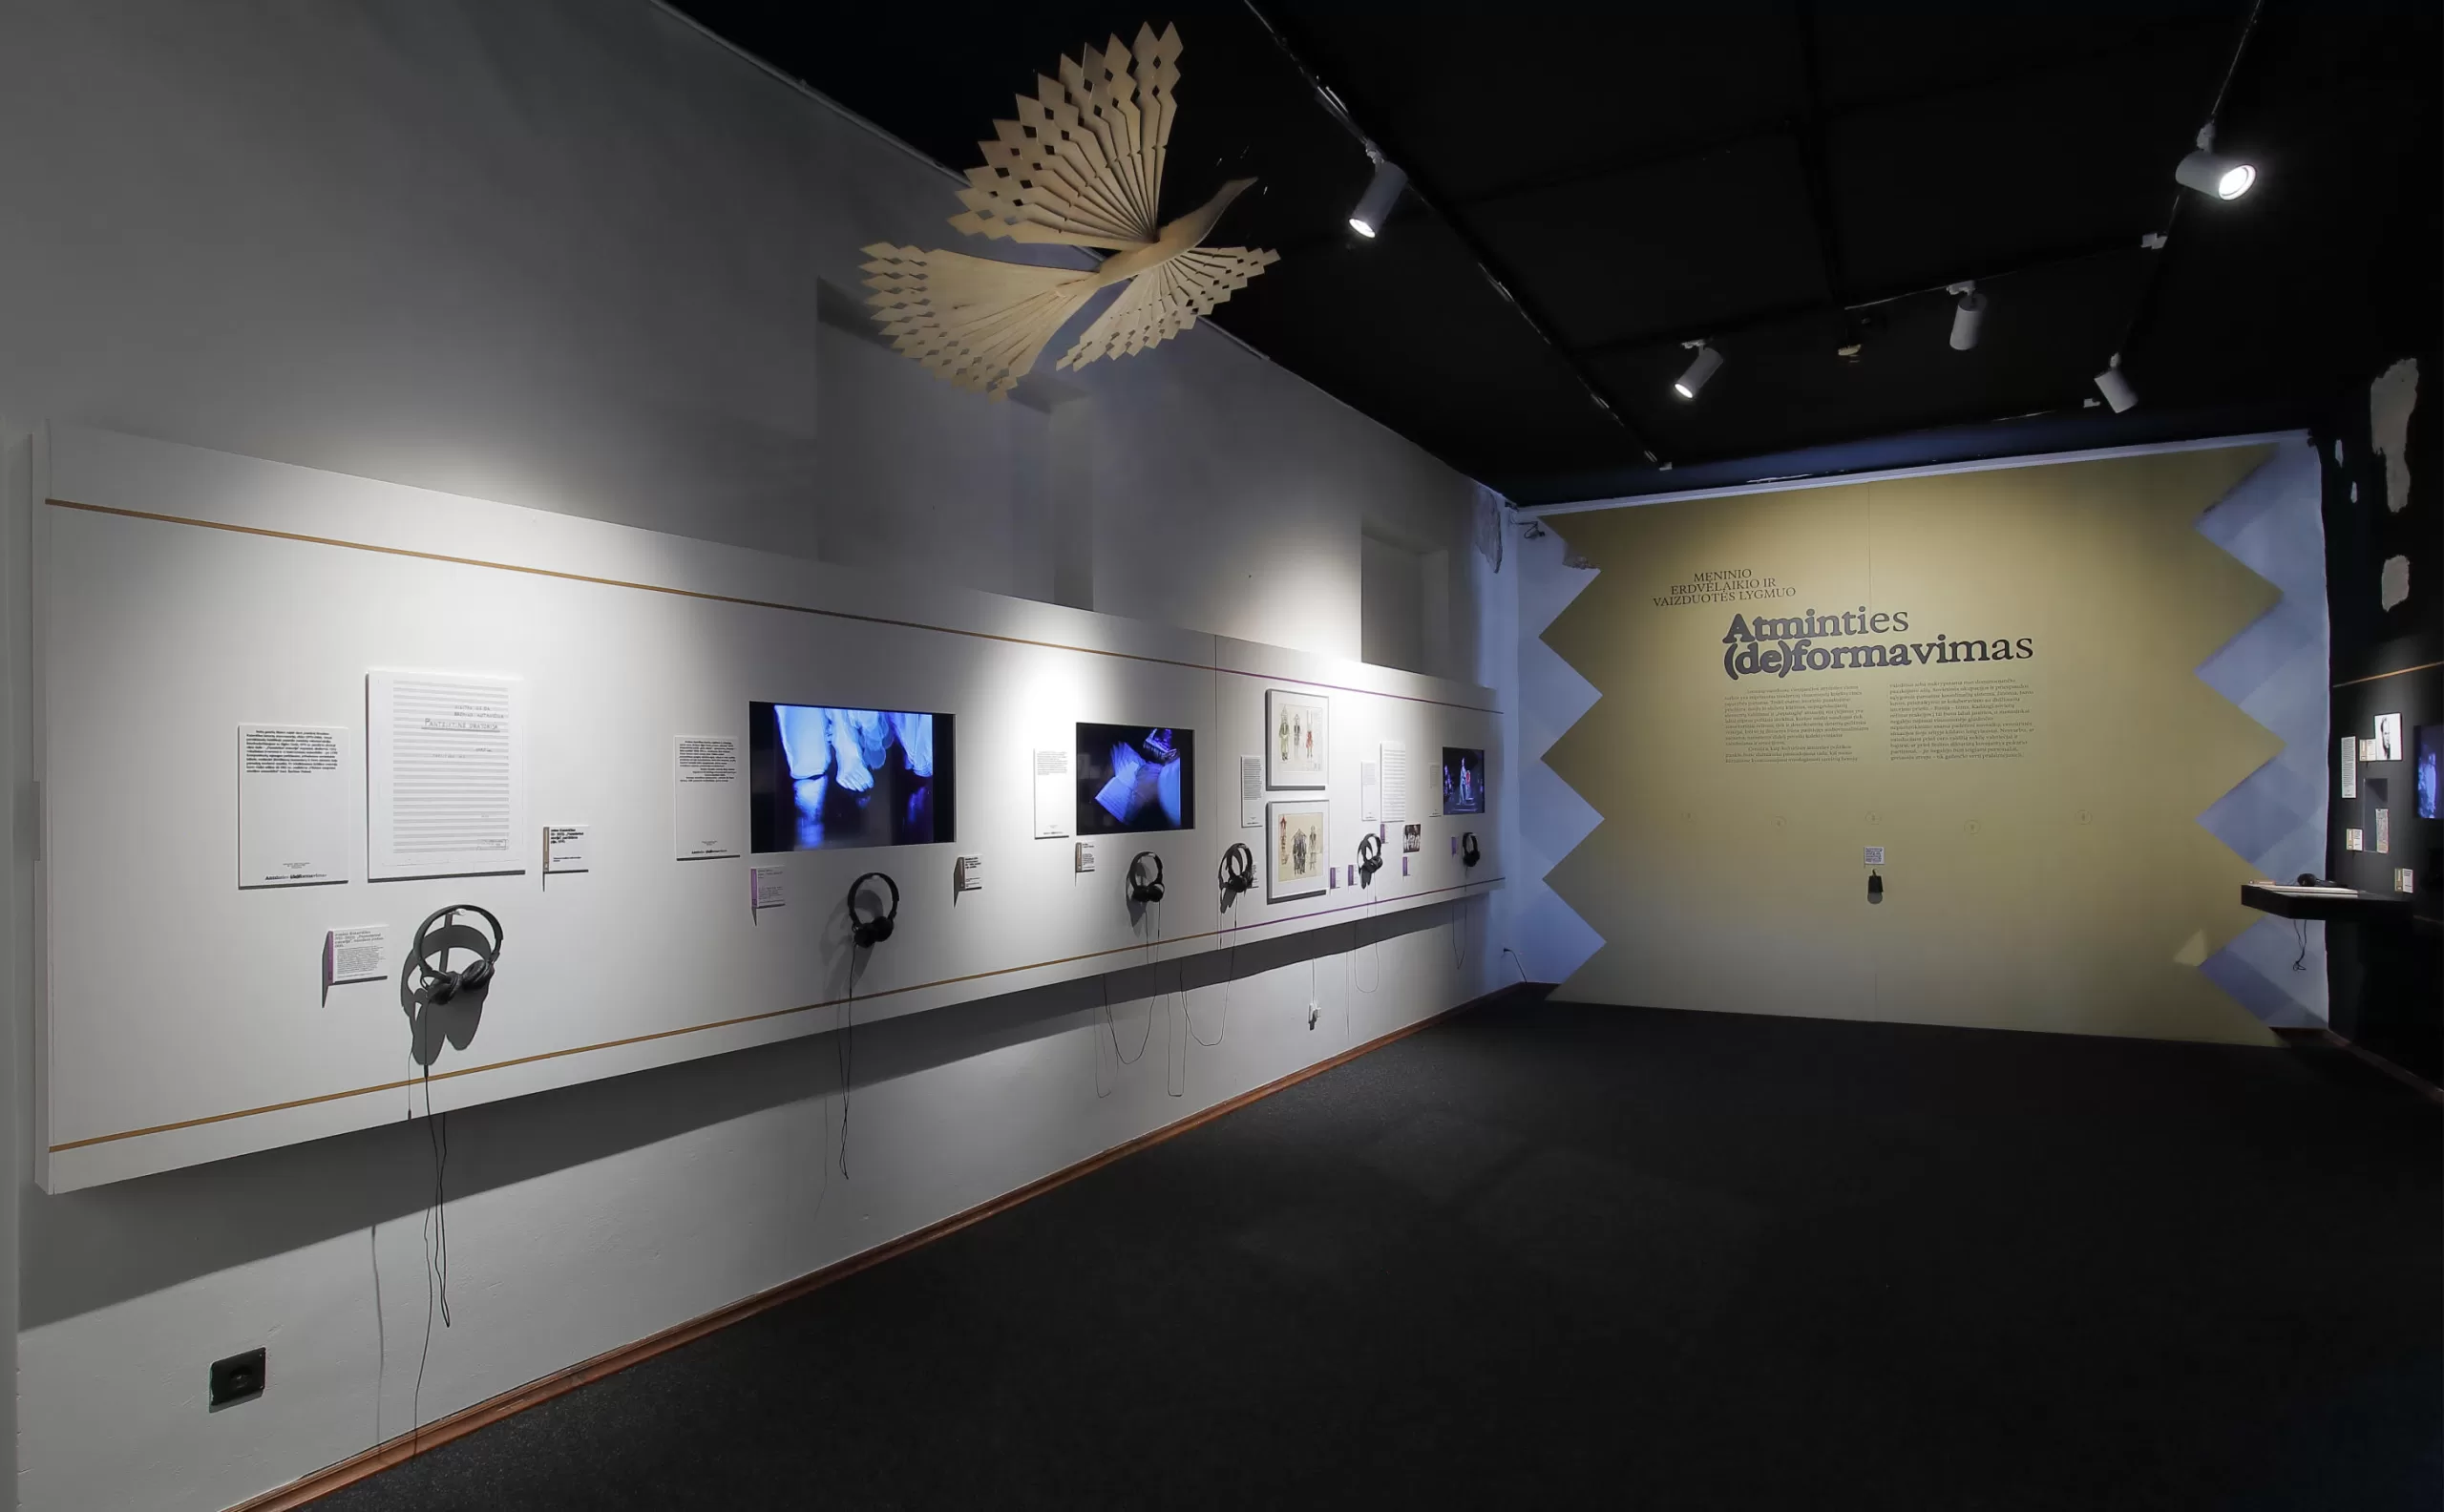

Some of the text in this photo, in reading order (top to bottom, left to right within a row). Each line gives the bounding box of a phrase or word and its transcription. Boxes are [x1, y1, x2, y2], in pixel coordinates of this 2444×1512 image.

[1694, 568, 1752, 583] MENINIO
[1653, 587, 1797, 608] VAIZDUOTĖS LYGMUO
[1671, 578, 1777, 596] ERDVĖLAIKIO IR
[1722, 606, 1909, 643] Atminties
[1724, 634, 2033, 681] (de)formavimas
